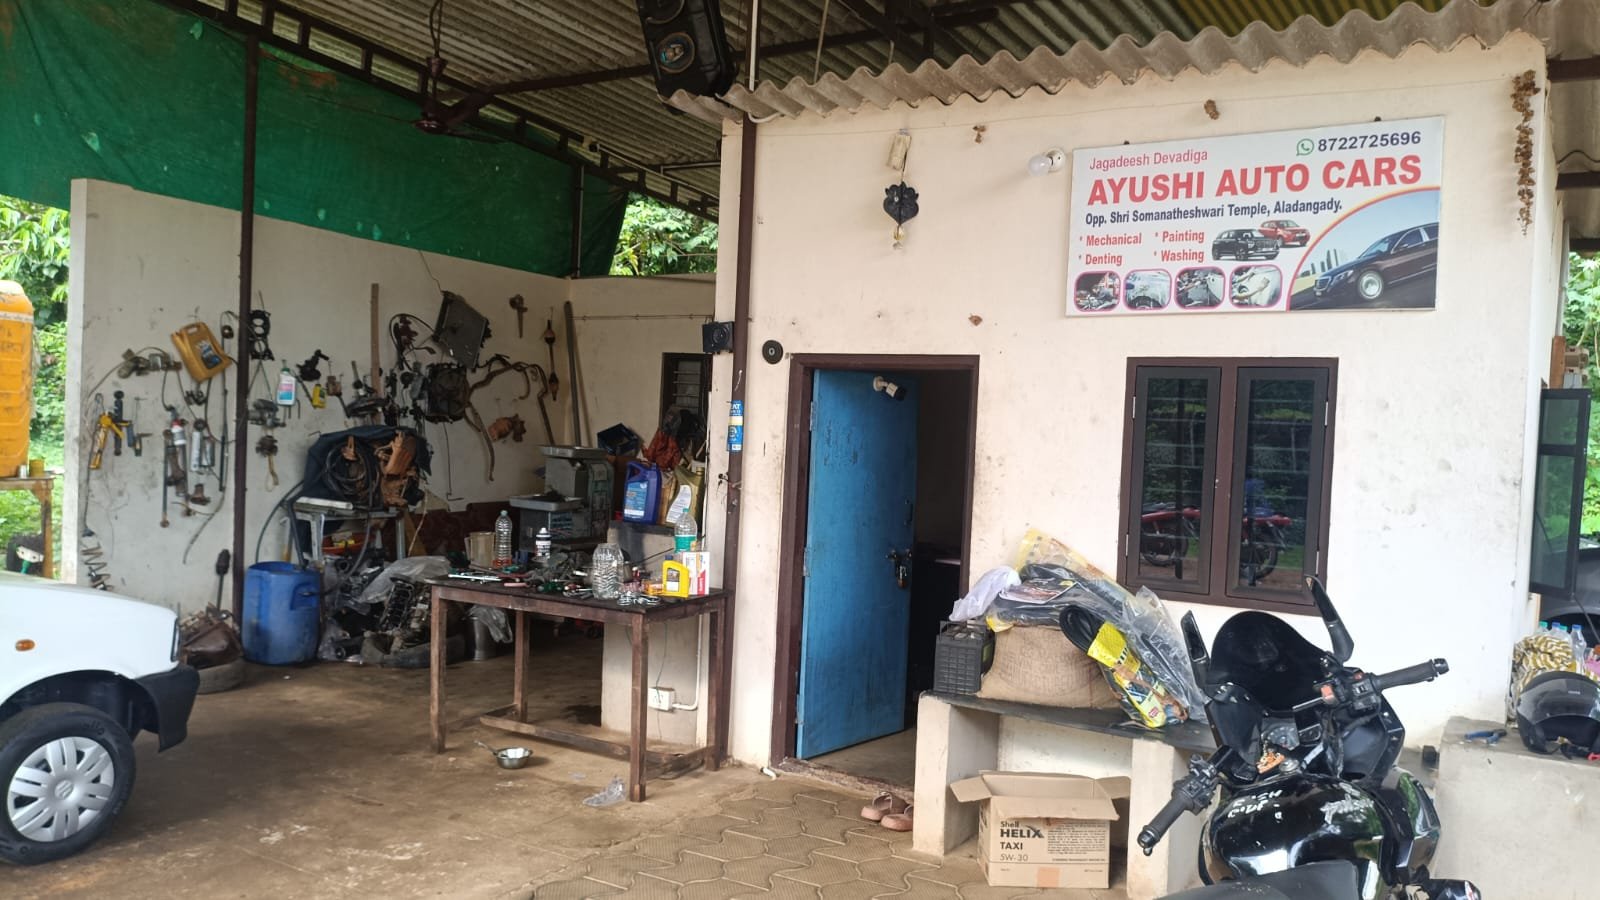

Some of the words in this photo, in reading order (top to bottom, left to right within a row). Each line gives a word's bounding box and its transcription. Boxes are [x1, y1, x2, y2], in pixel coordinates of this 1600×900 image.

[1318, 131, 1421, 152] 8722725696
[1089, 153, 1150, 171] Jagadeesh
[1153, 149, 1208, 166] Devadiga
[1087, 171, 1205, 205] AYUSHI
[1216, 164, 1310, 196] AUTO
[1322, 154, 1422, 189] CARS
[1085, 212, 1107, 227] Opp.
[1110, 210, 1130, 224] Shri
[1132, 205, 1224, 222] Somanatheshwari
[1228, 202, 1271, 218] Temple,
[1273, 198, 1343, 214] Aladangady.
[1086, 232, 1142, 247] Mechanical
[1162, 230, 1205, 245] Painting
[1085, 253, 1123, 266] Denting
[1161, 249, 1204, 264] Washing
[1000, 828, 1044, 839] HELIX
[1000, 841, 1023, 850] TAXI
